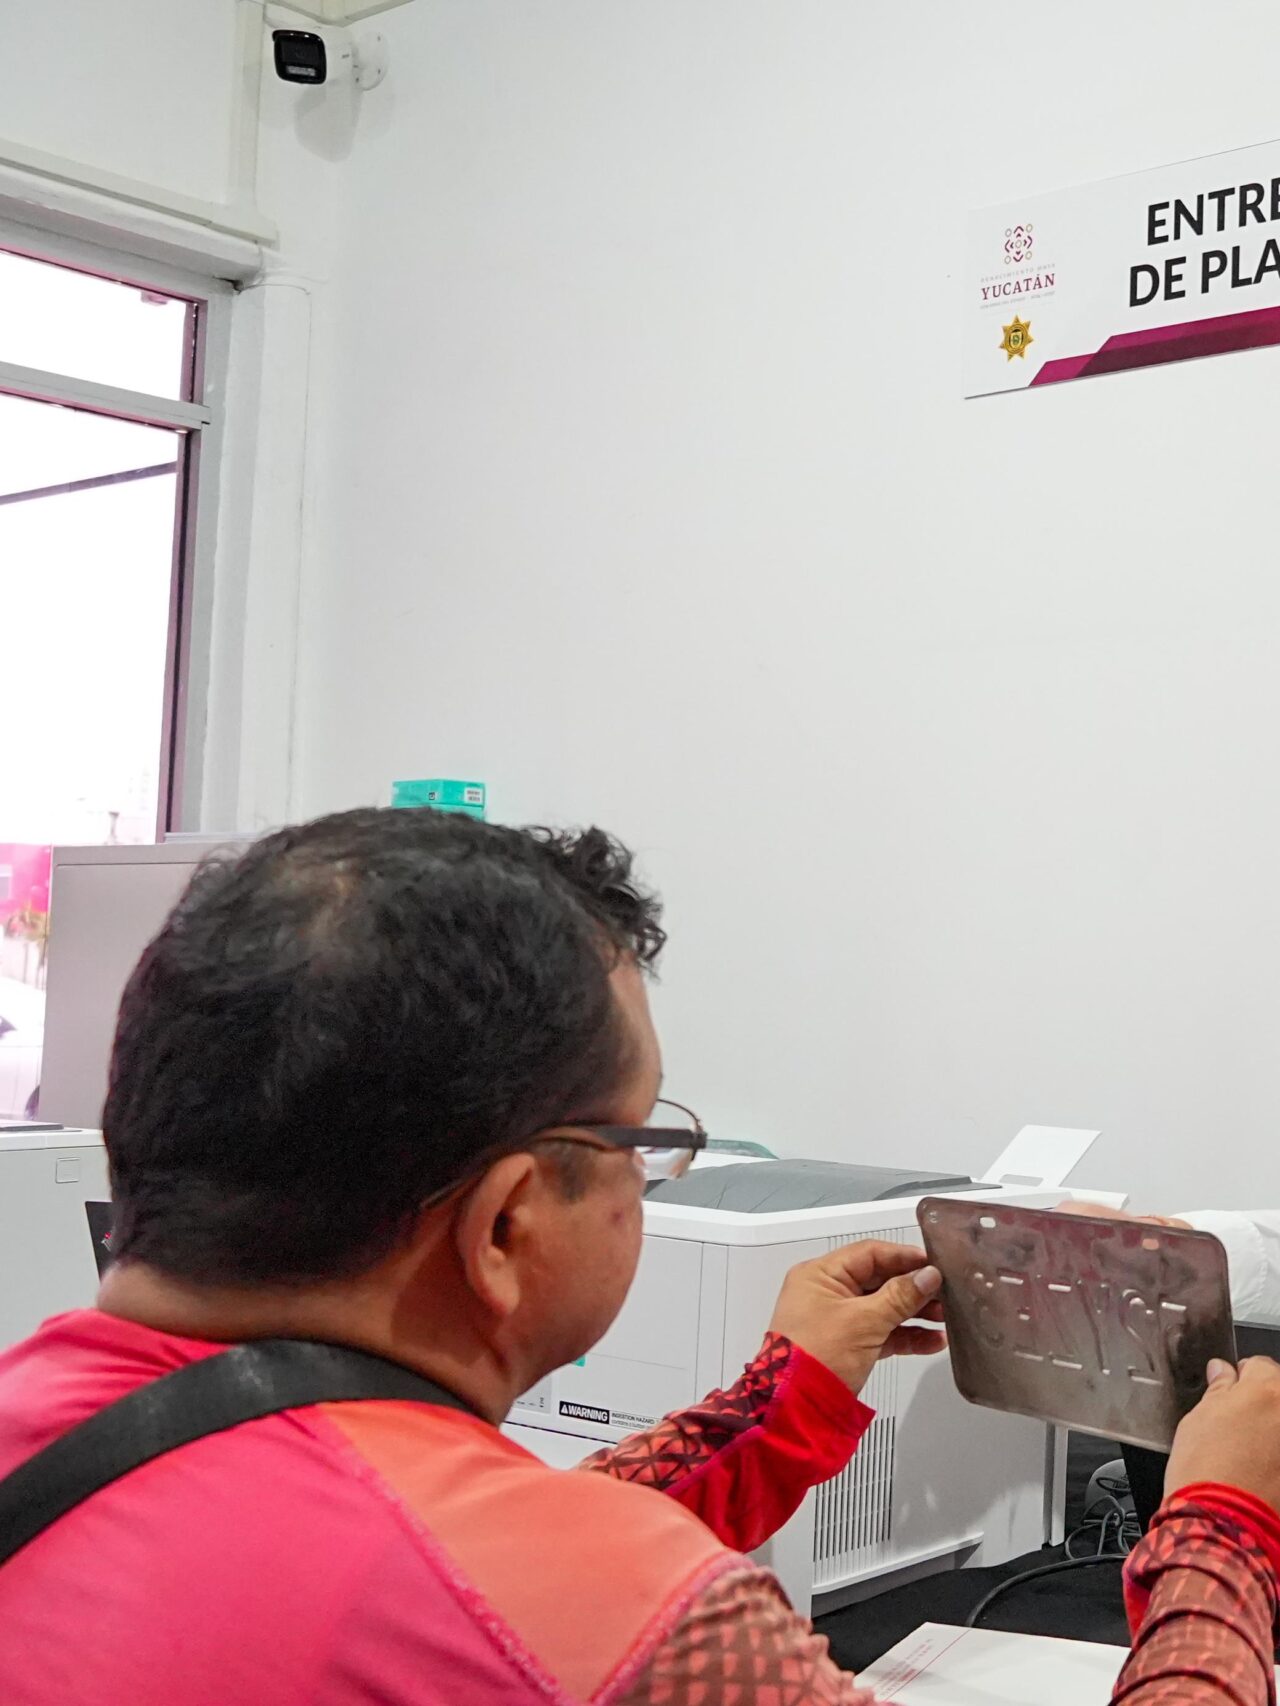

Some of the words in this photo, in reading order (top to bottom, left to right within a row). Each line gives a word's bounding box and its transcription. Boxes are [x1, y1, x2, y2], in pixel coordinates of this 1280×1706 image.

[981, 273, 1055, 300] YUCATÁN
[1129, 256, 1186, 308] DE
[568, 1404, 608, 1421] WARNING
